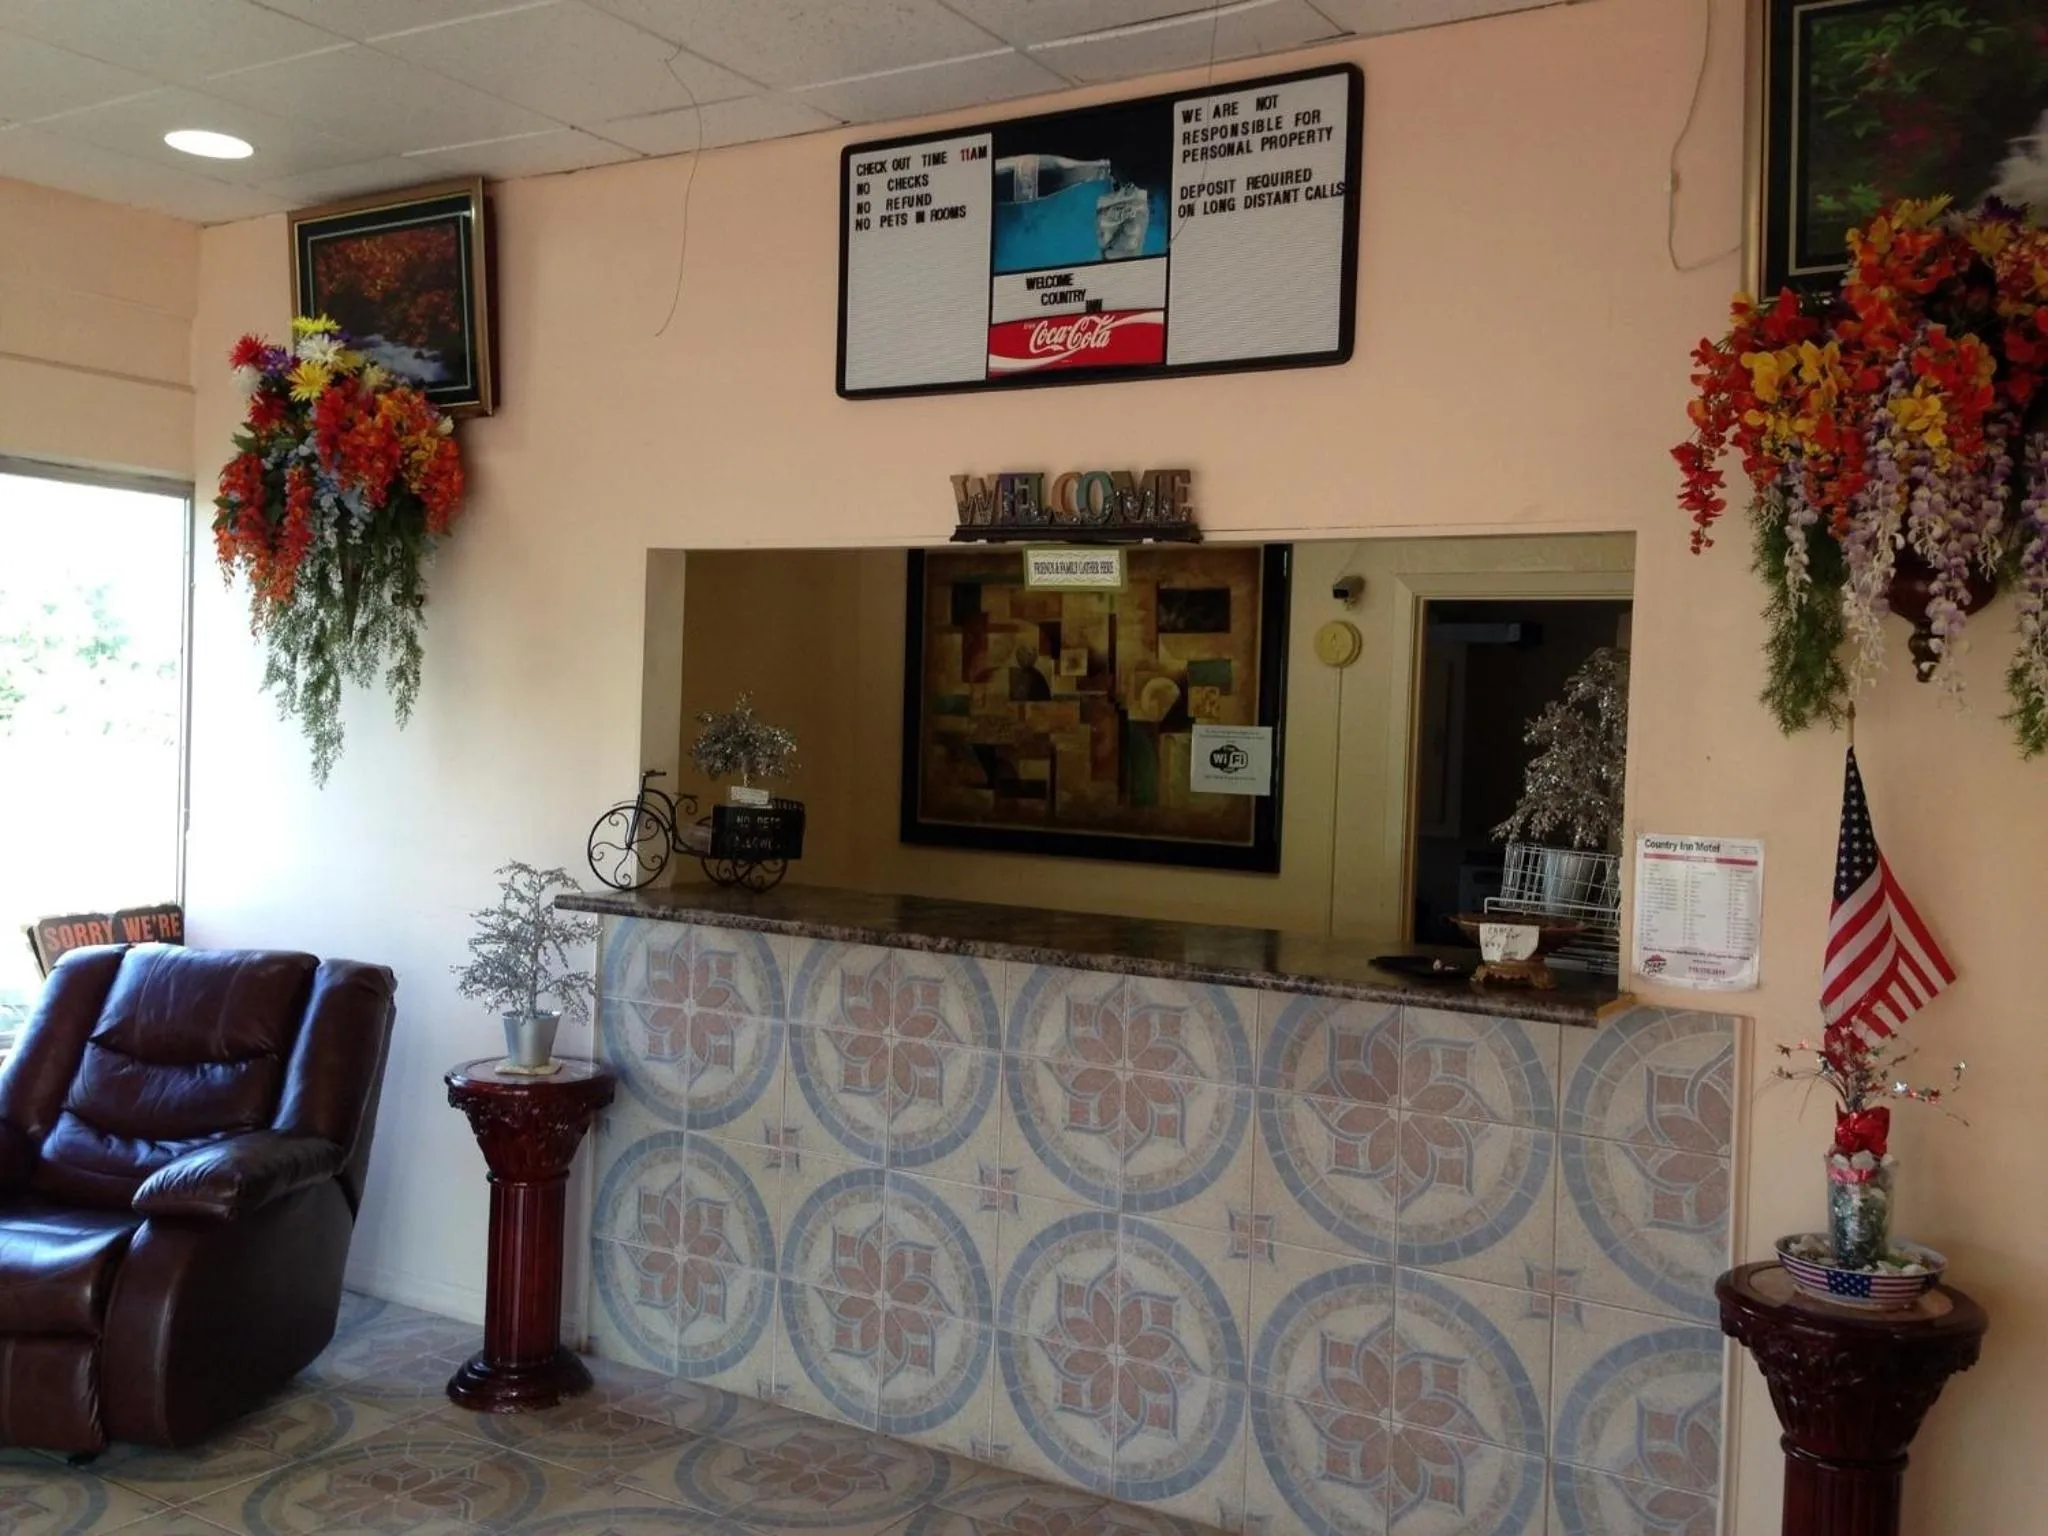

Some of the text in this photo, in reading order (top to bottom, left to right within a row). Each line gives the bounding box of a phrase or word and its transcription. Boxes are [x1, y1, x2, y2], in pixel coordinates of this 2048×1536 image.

[1182, 94, 1279, 124] WE ARE NOT
[1182, 109, 1321, 145] RESPONSIBLE FOR
[1182, 126, 1333, 164] PERSONAL PROPERTY
[856, 145, 988, 177] CHECK OUT TIME 11AM
[856, 174, 929, 195] NO CHECKS
[1180, 167, 1312, 200] DEPOSIT REQUIRED
[856, 193, 932, 215] NO REFUND
[1178, 181, 1346, 219] ON LONG DISTANT CALLS
[855, 204, 967, 231] NO PETS IN ROOMS
[1026, 273, 1074, 290] WELCOME
[1041, 289, 1086, 306] COUNTRY
[950, 469, 1193, 526] WELCOME
[1644, 839, 1677, 852] Country
[1679, 841, 1694, 851] Inn
[1695, 842, 1720, 853] Motel
[44, 912, 181, 951] SORRY WE'RE
